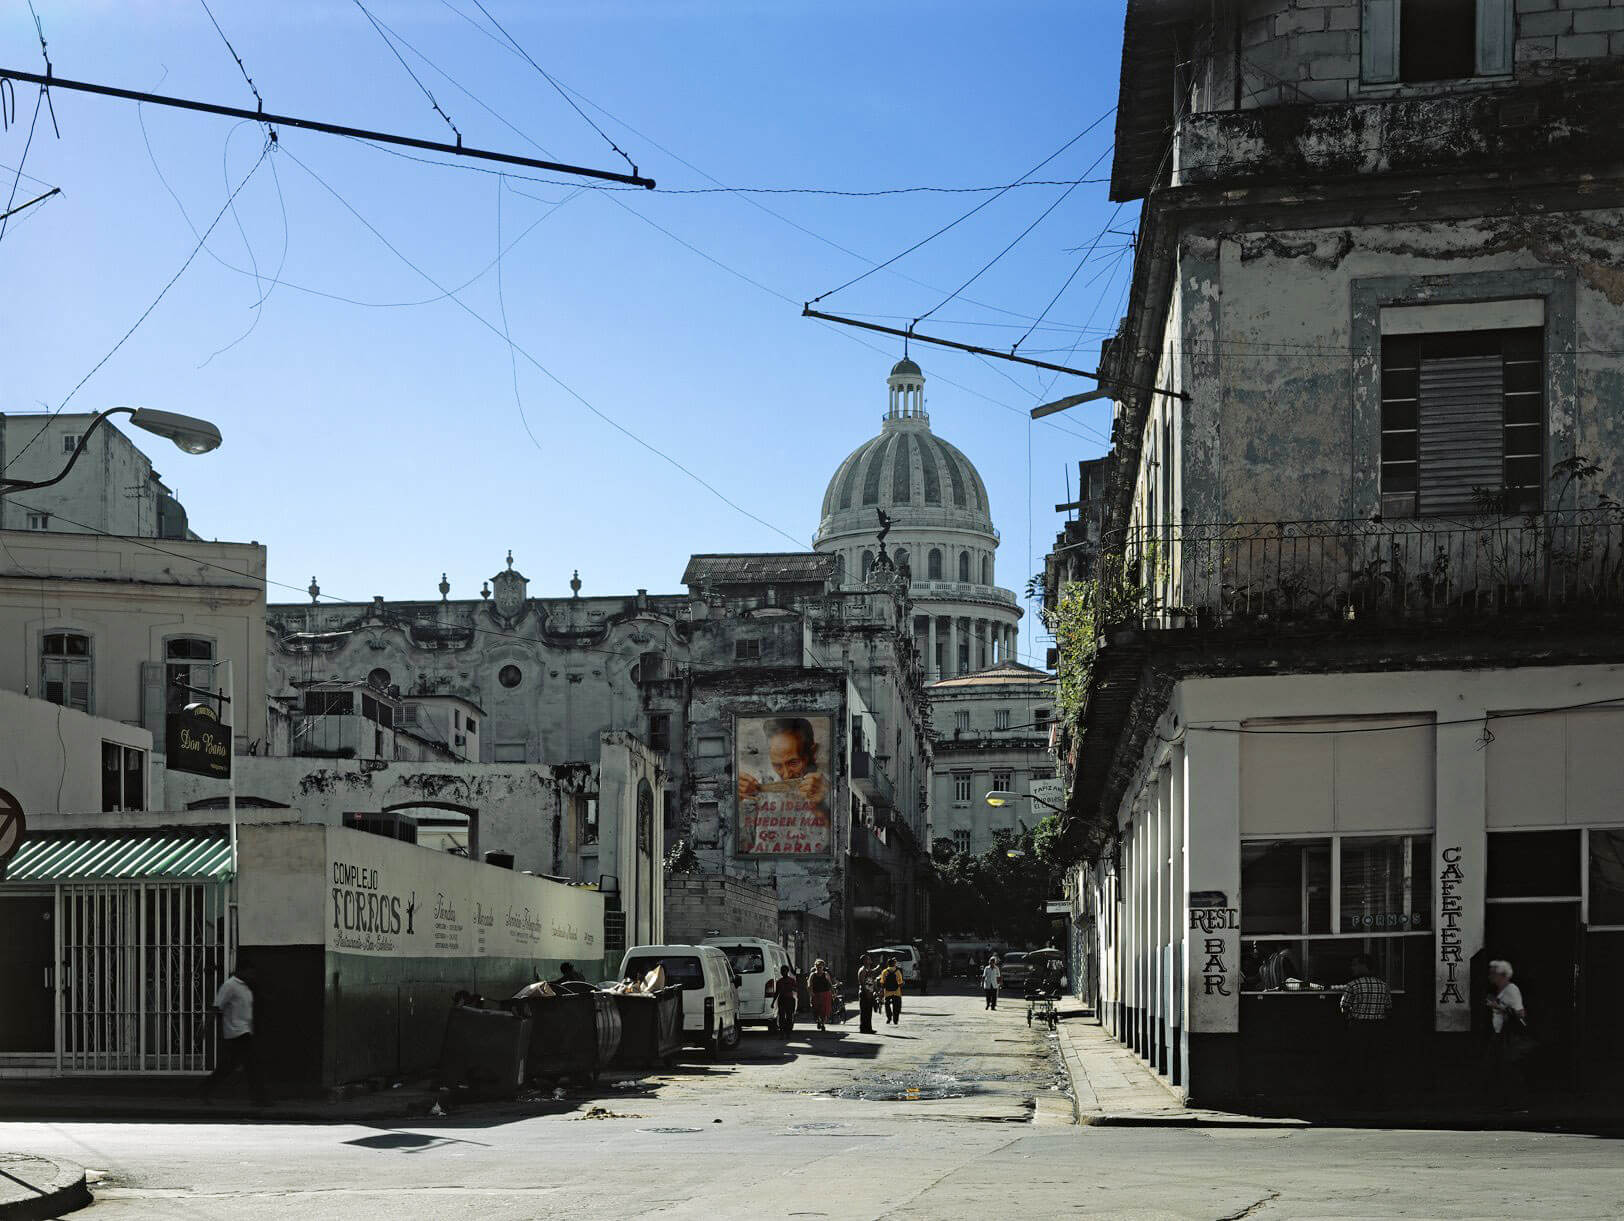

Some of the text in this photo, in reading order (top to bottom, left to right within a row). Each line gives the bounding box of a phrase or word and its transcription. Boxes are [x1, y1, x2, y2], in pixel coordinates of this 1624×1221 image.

[181, 728, 200, 751] Don
[333, 861, 378, 890] COMPLEJO
[332, 887, 401, 935] FORNOS
[1352, 912, 1423, 928] FORNOS
[1440, 846, 1465, 1004] CAFETERIA
[1203, 938, 1231, 997] BAR
